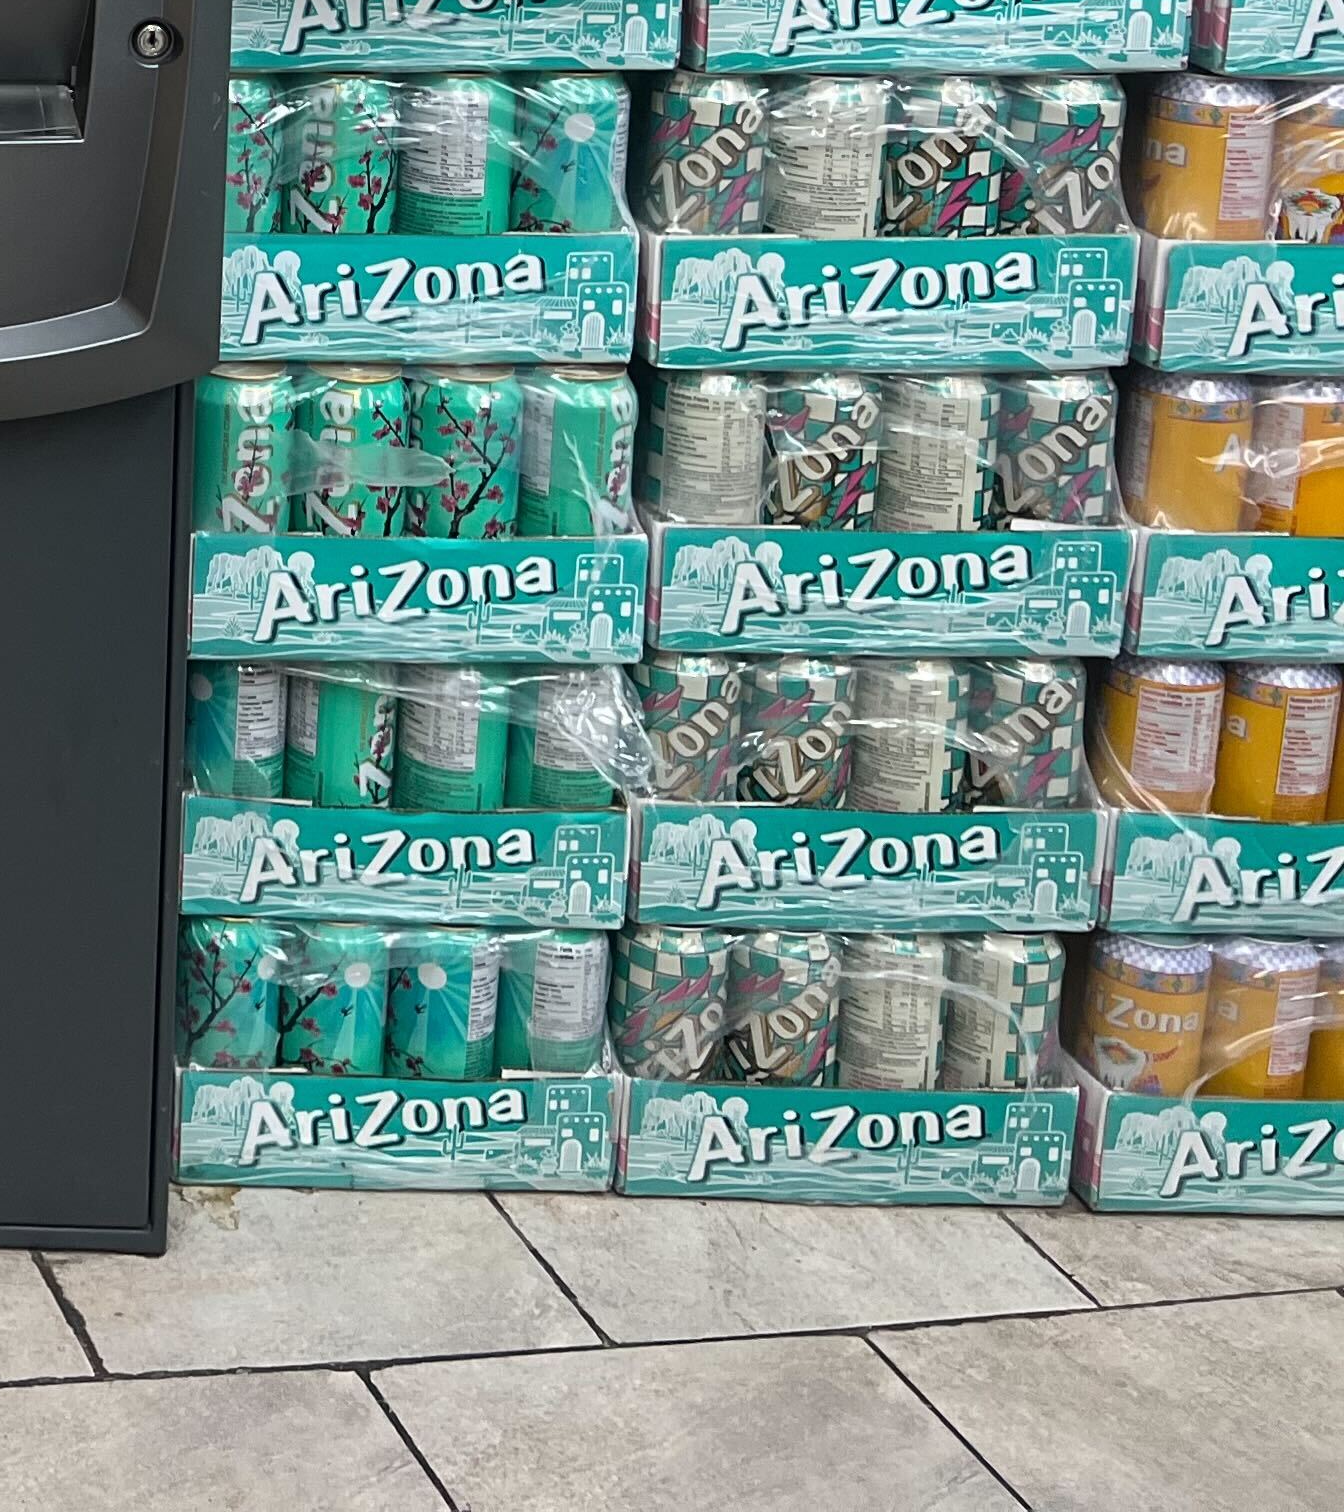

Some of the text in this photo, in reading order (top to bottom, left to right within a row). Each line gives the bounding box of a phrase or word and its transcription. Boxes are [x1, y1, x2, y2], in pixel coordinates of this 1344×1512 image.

[240, 252, 546, 345] AriZona
[721, 251, 1039, 350] AriZona
[253, 554, 557, 643] AriZona
[720, 541, 1032, 636] AriZona
[1204, 567, 1344, 647] Ari
[240, 827, 535, 905] AriZona
[697, 826, 1002, 910] AriZona
[240, 1086, 529, 1167] AriZona
[688, 1104, 988, 1183] AriZona
